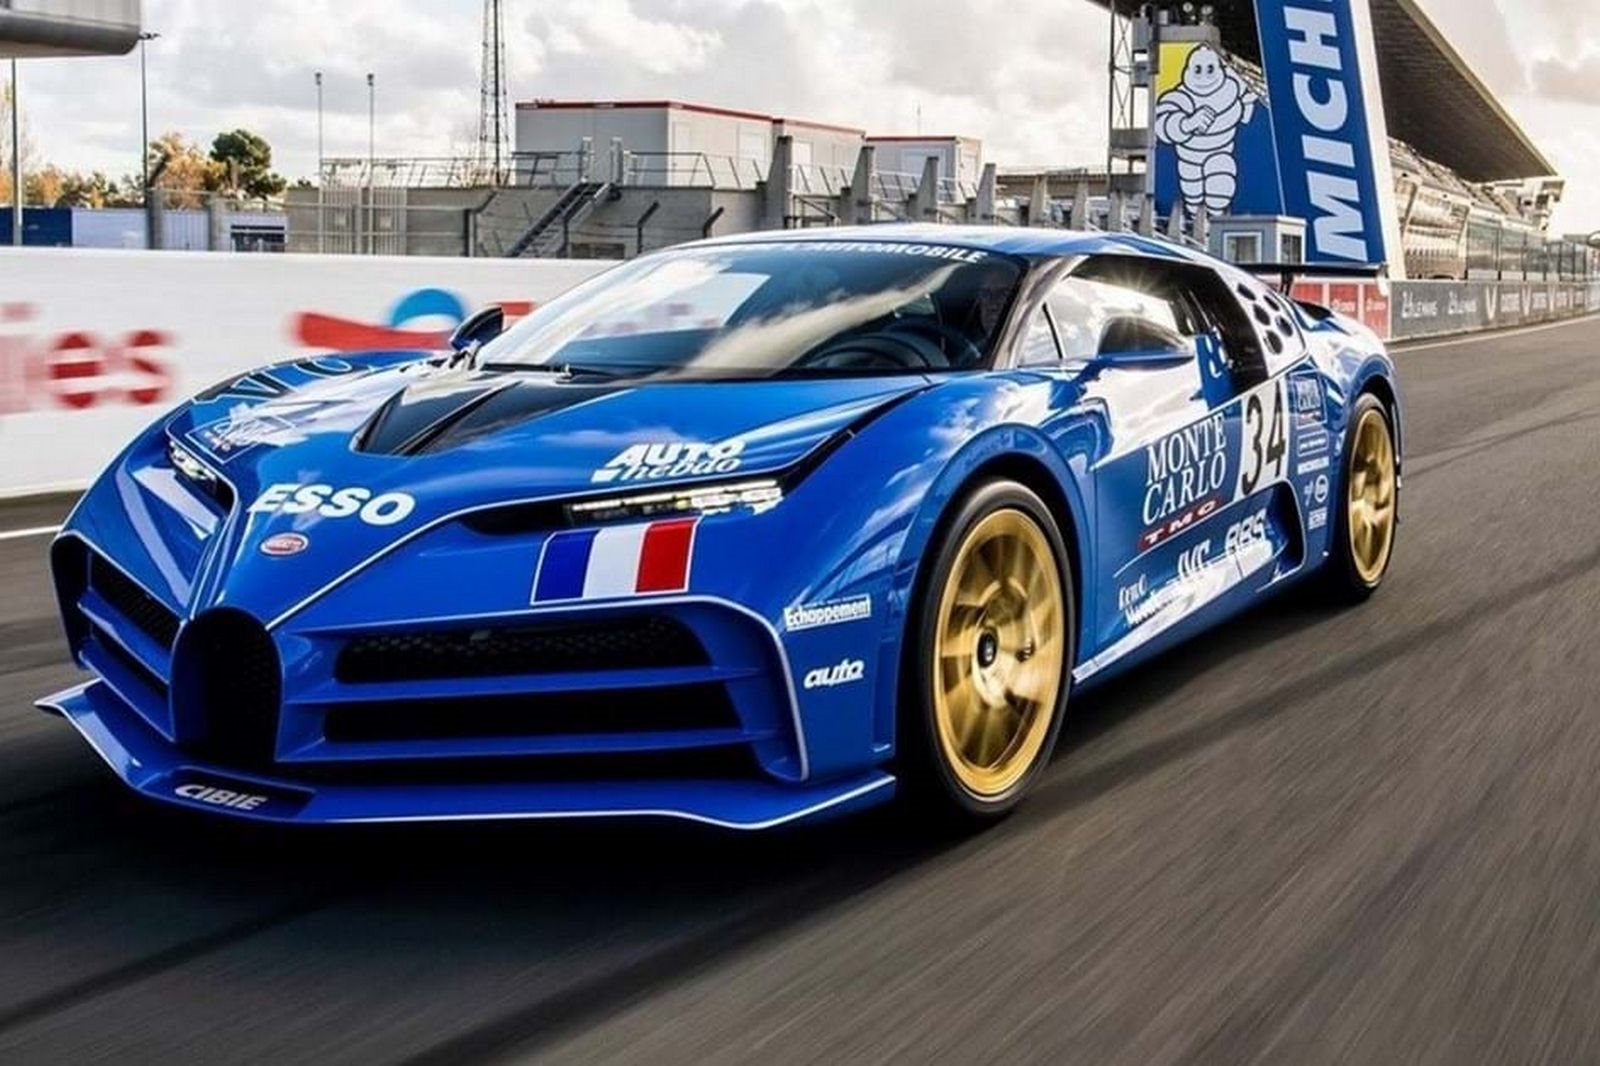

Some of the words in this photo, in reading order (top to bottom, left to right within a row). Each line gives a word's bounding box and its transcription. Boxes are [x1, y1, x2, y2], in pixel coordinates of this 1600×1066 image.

[1283, 0, 1368, 262] MICH
[1146, 411, 1227, 486] MONTE
[1241, 378, 1287, 496] 34
[597, 442, 746, 478] AUTO
[620, 458, 742, 481] hebdo
[247, 484, 416, 526] ESSO
[1142, 450, 1226, 526] CARLO
[803, 658, 865, 689] auto
[174, 784, 269, 811] CIBIE
